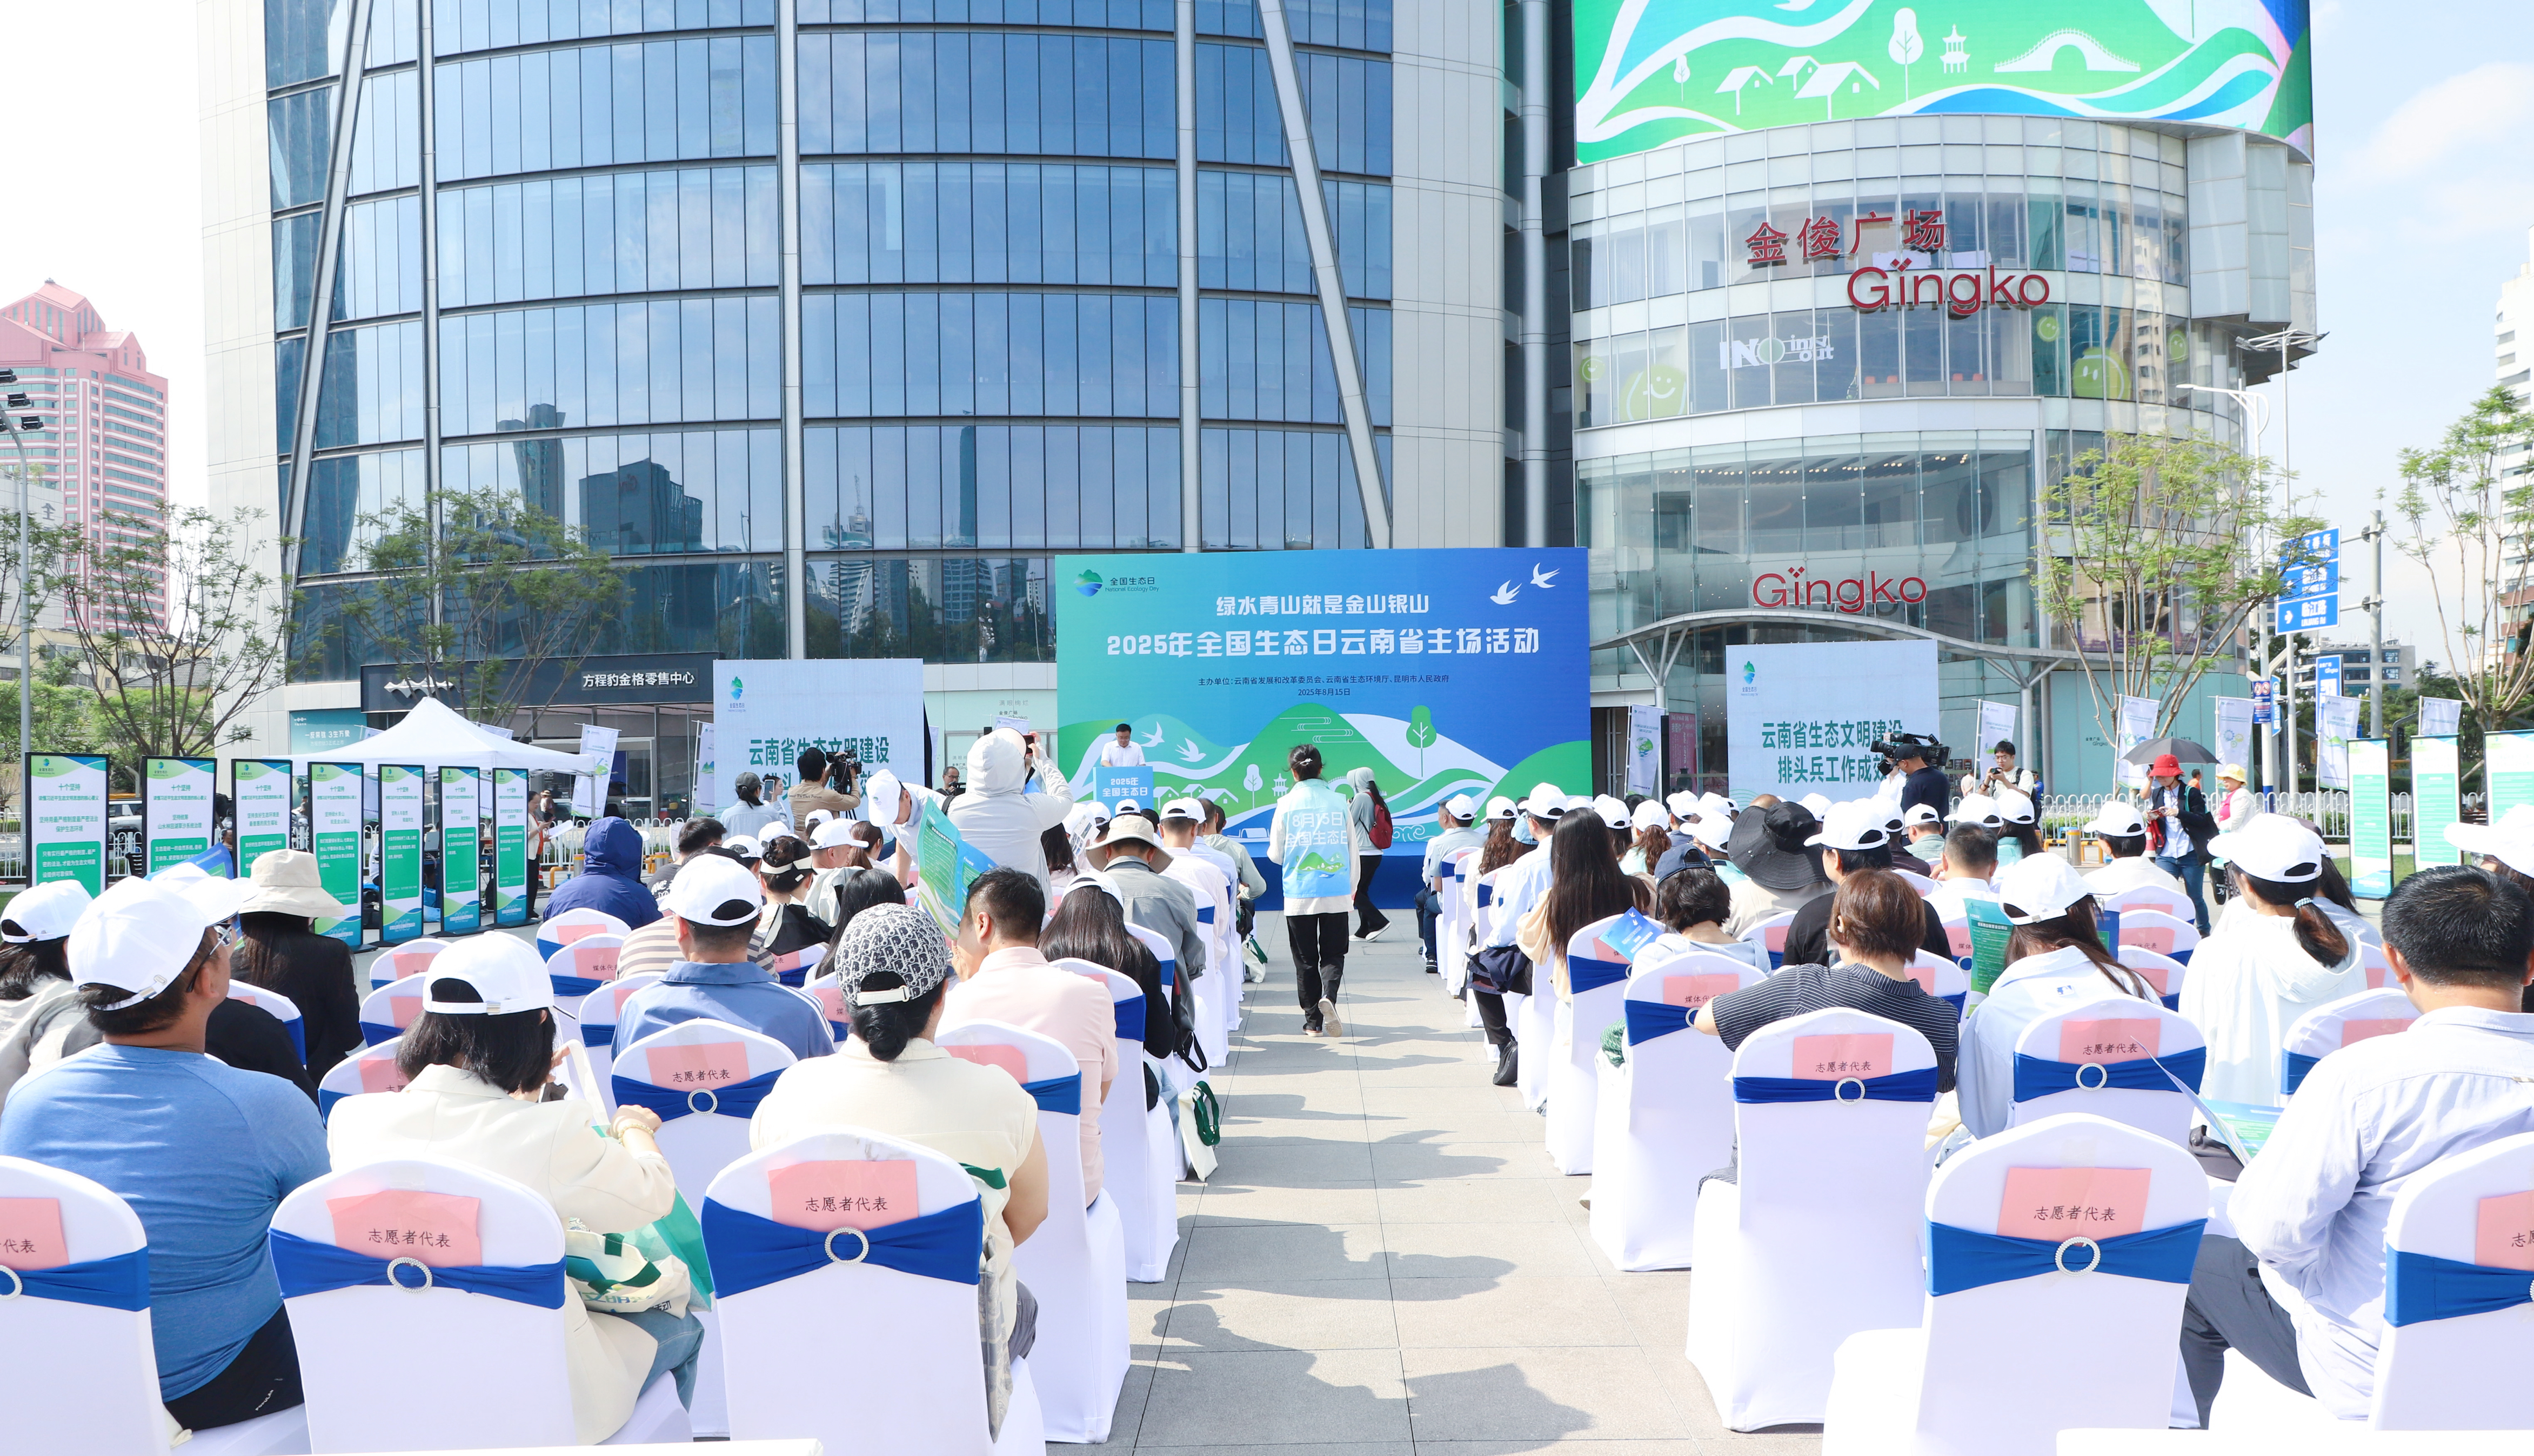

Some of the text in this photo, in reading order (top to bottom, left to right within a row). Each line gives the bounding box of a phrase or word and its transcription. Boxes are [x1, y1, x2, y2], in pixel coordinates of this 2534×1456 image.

[1745, 209, 1948, 265] 金俊广场
[1847, 257, 2050, 316] Gingko
[1110, 577, 1155, 586] 全国生态日
[1753, 566, 1928, 613] Gingko
[1216, 594, 1429, 616] 绿水青山就是金山银山
[2302, 600, 2326, 617] 临江路
[1107, 627, 1540, 659] 2025年全国生态日云南省主场活动
[583, 672, 695, 687] 方程豹金格零售中心
[1298, 688, 1351, 697] 2025年8月15日
[1110, 777, 1139, 786] 2025年
[1102, 787, 1148, 797] 全国生态日
[1292, 812, 1343, 828] 8月15日
[2082, 1042, 2138, 1056] 志愿者代表
[1815, 1061, 1872, 1073] 志愿者代表
[672, 1068, 731, 1083] 志愿者代表
[805, 1196, 888, 1213] 志愿者代表
[2034, 1205, 2116, 1222] 志愿者代表
[0, 1238, 36, 1253] 代表
[368, 1228, 452, 1249] 志愿者代表
